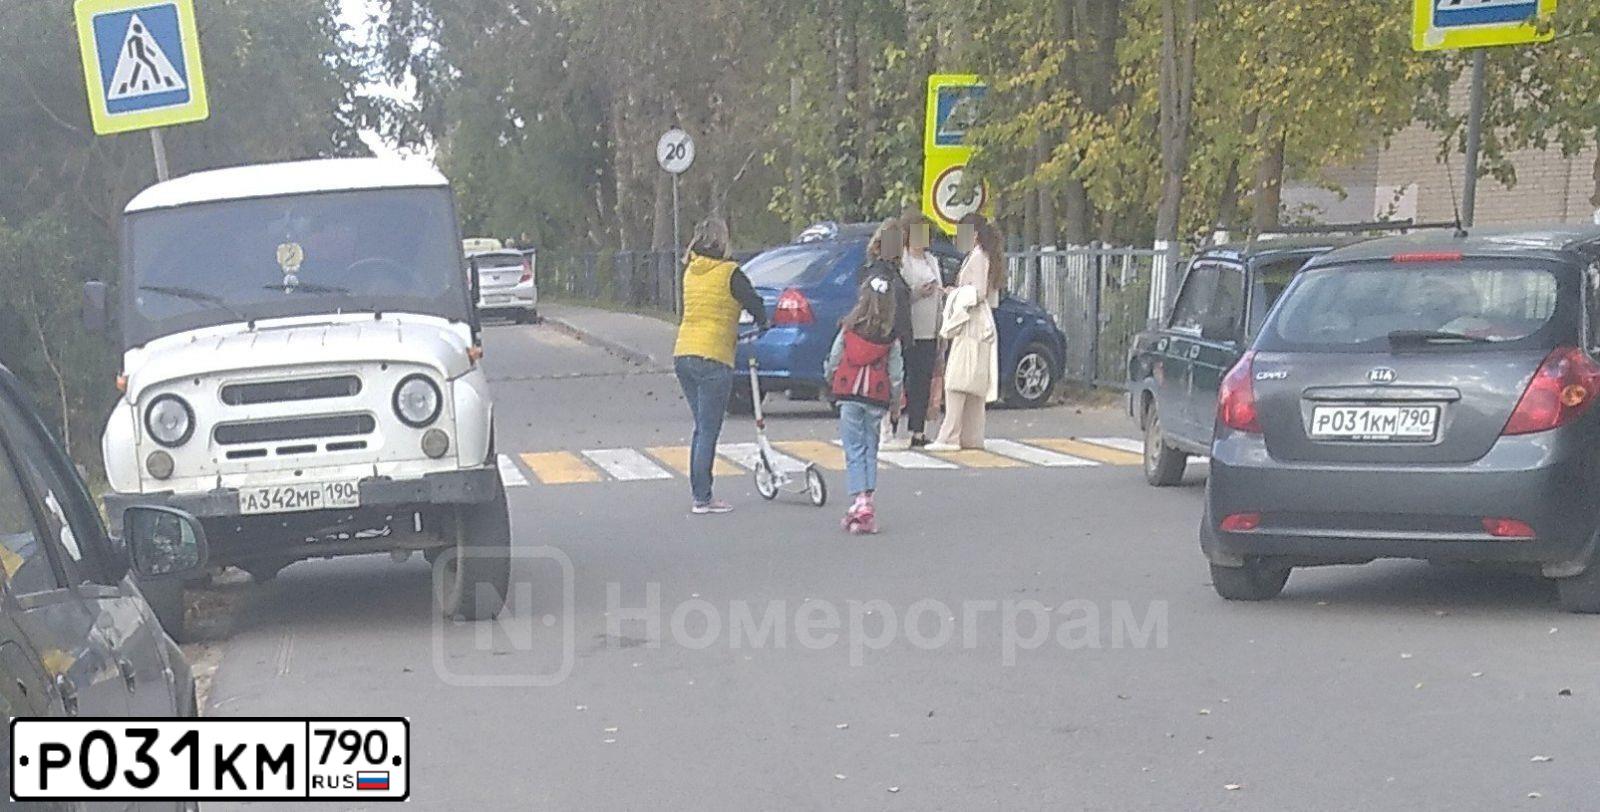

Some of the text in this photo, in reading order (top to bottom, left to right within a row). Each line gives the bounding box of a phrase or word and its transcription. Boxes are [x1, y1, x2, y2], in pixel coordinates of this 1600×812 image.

[665, 142, 685, 160] 20
[1370, 369, 1393, 381] KIA
[1318, 409, 1430, 431] Р031КМ 790
[247, 482, 353, 510] А342МР 190
